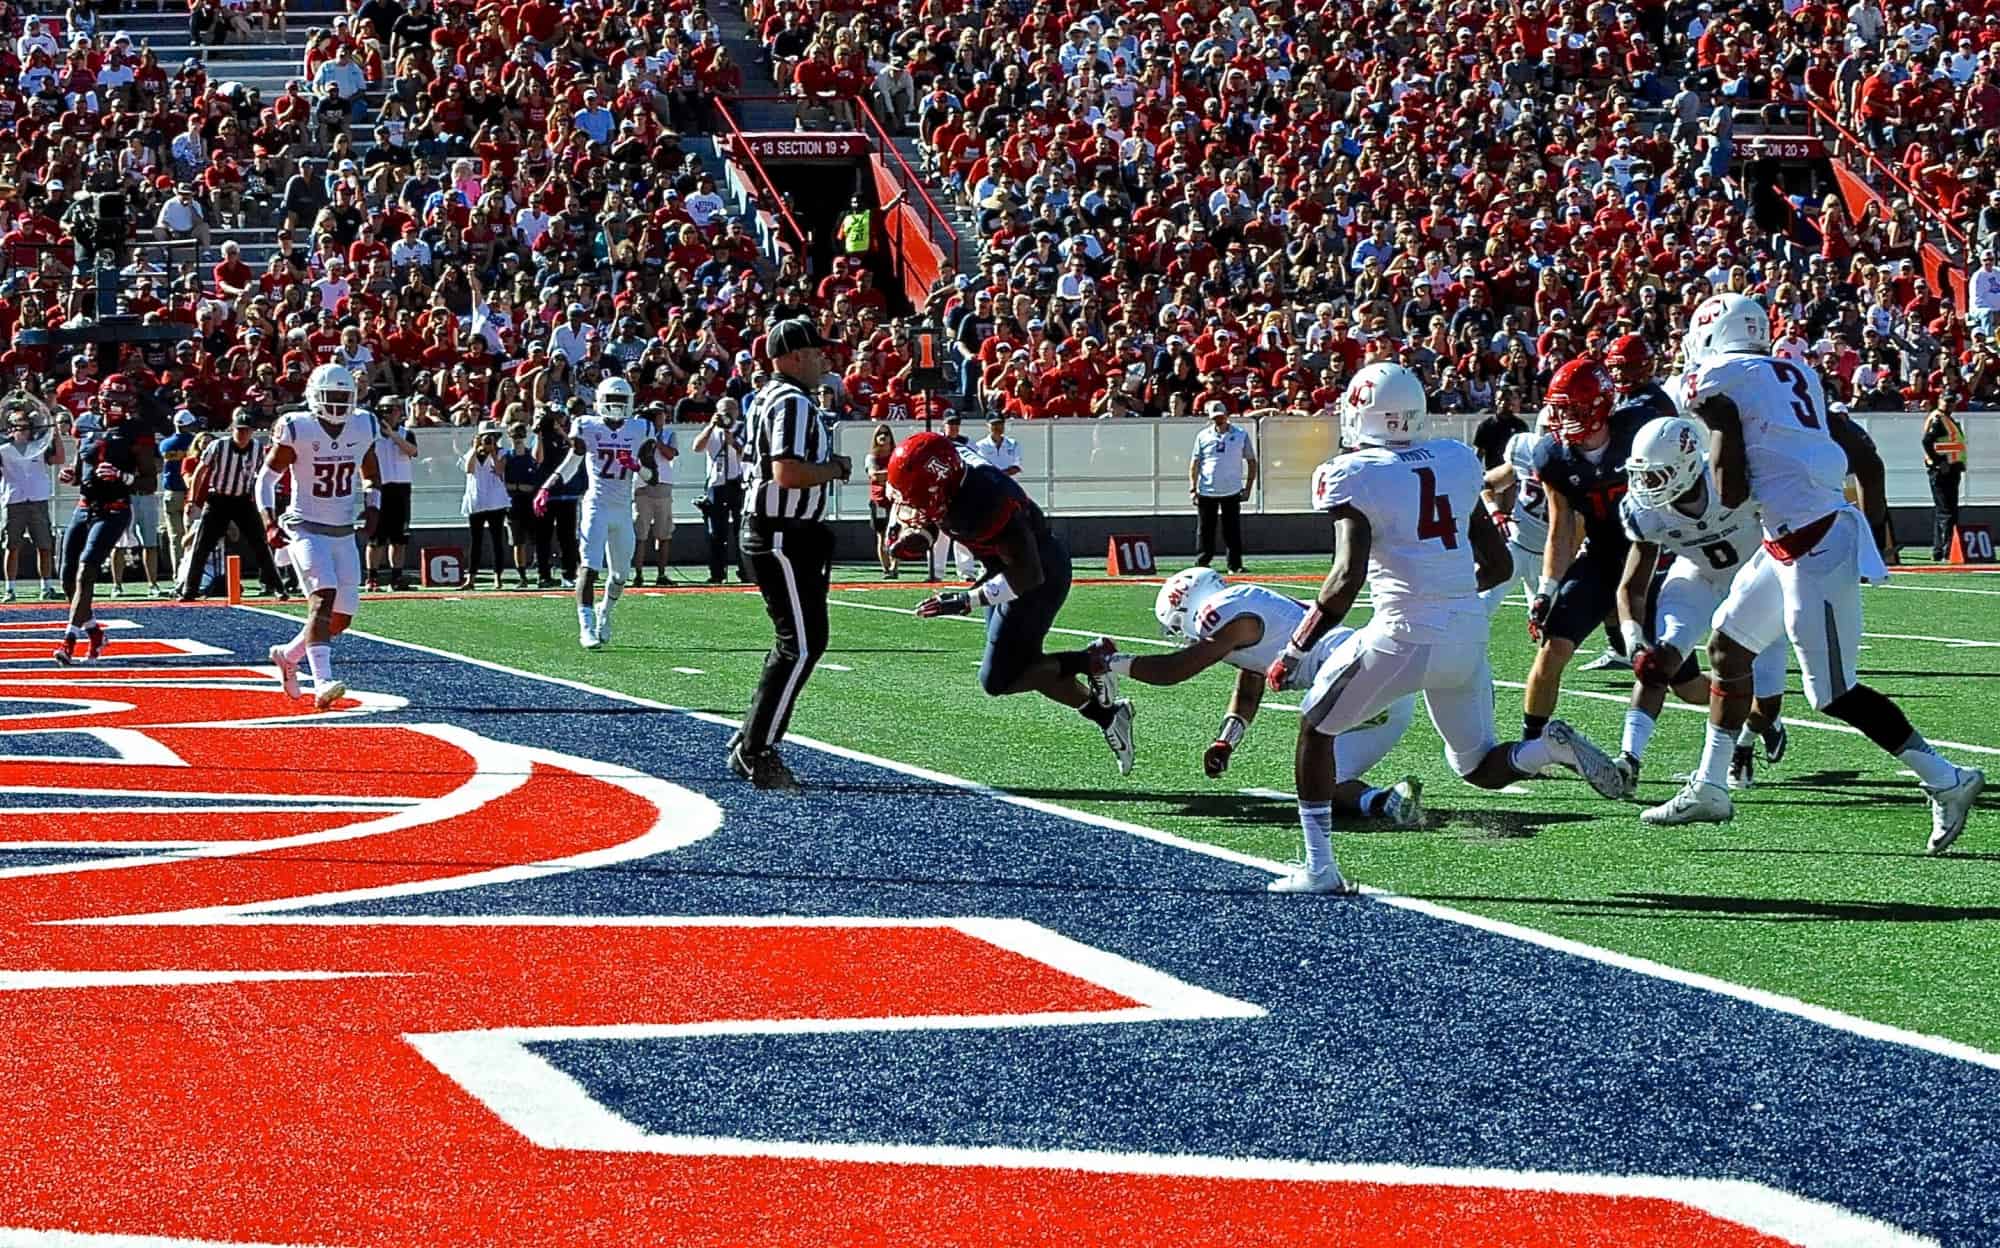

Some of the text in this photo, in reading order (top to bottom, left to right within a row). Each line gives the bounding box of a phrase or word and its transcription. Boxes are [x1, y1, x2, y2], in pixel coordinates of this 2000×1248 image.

[762, 141, 837, 154] 18 SECTION 19
[1785, 143, 1798, 156] 20
[1687, 373, 1698, 400] 3
[1764, 360, 1821, 430] 3
[313, 462, 356, 498] 30
[1411, 467, 1458, 550] 4
[1120, 542, 1151, 569] 10
[1964, 531, 1992, 558] 20
[431, 556, 460, 583] G
